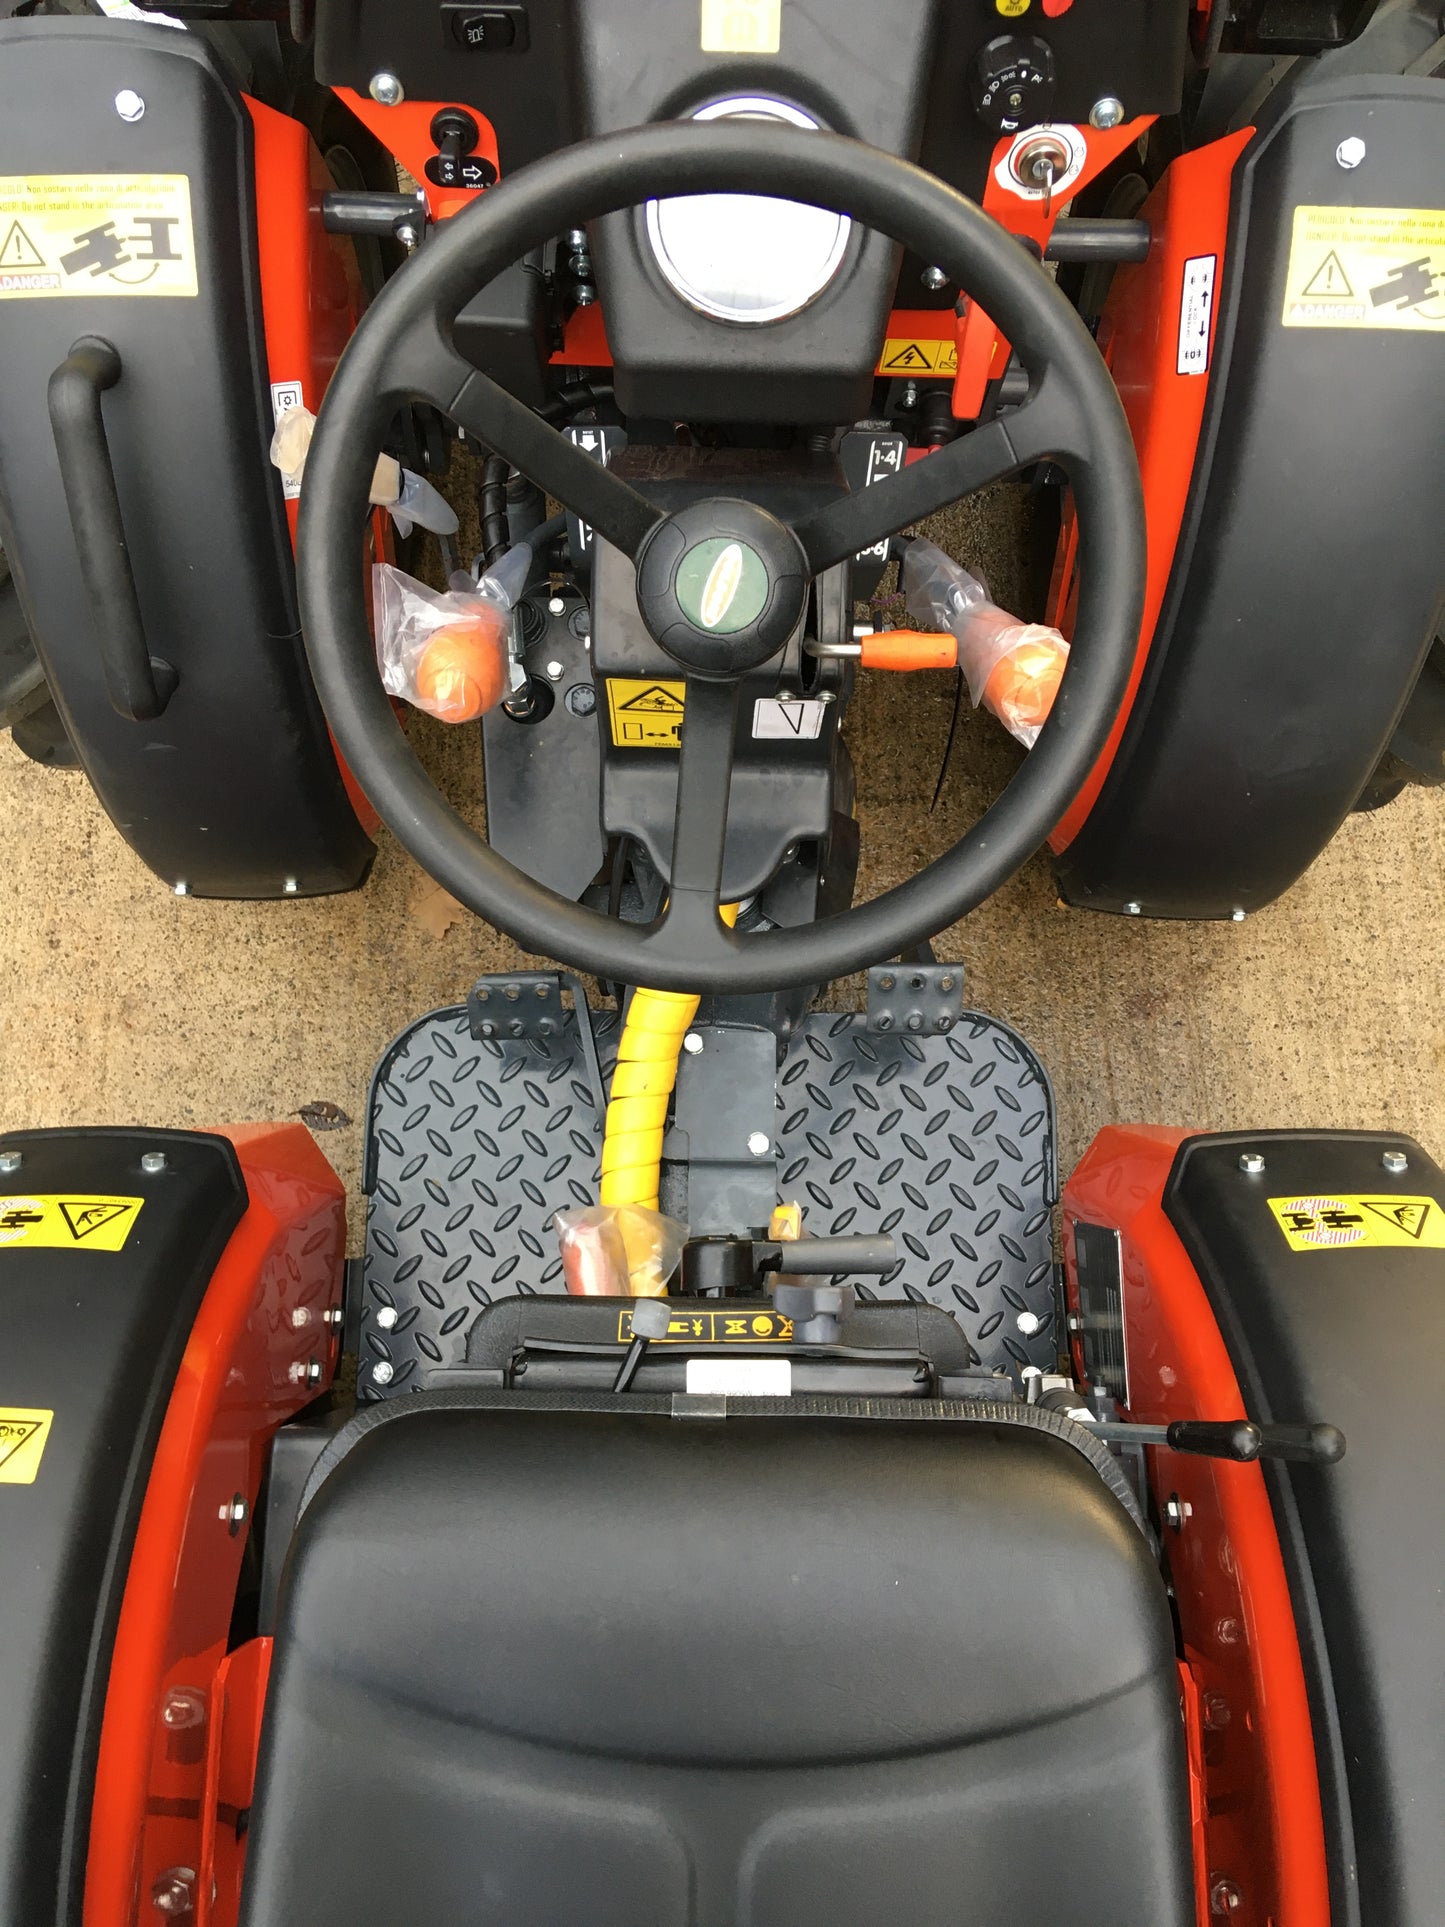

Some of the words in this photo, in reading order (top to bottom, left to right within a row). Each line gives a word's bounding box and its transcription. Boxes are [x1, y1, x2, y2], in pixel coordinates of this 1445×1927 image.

[49, 201, 70, 210] stand
[82, 201, 94, 209] the
[3, 274, 60, 290] DANGER
